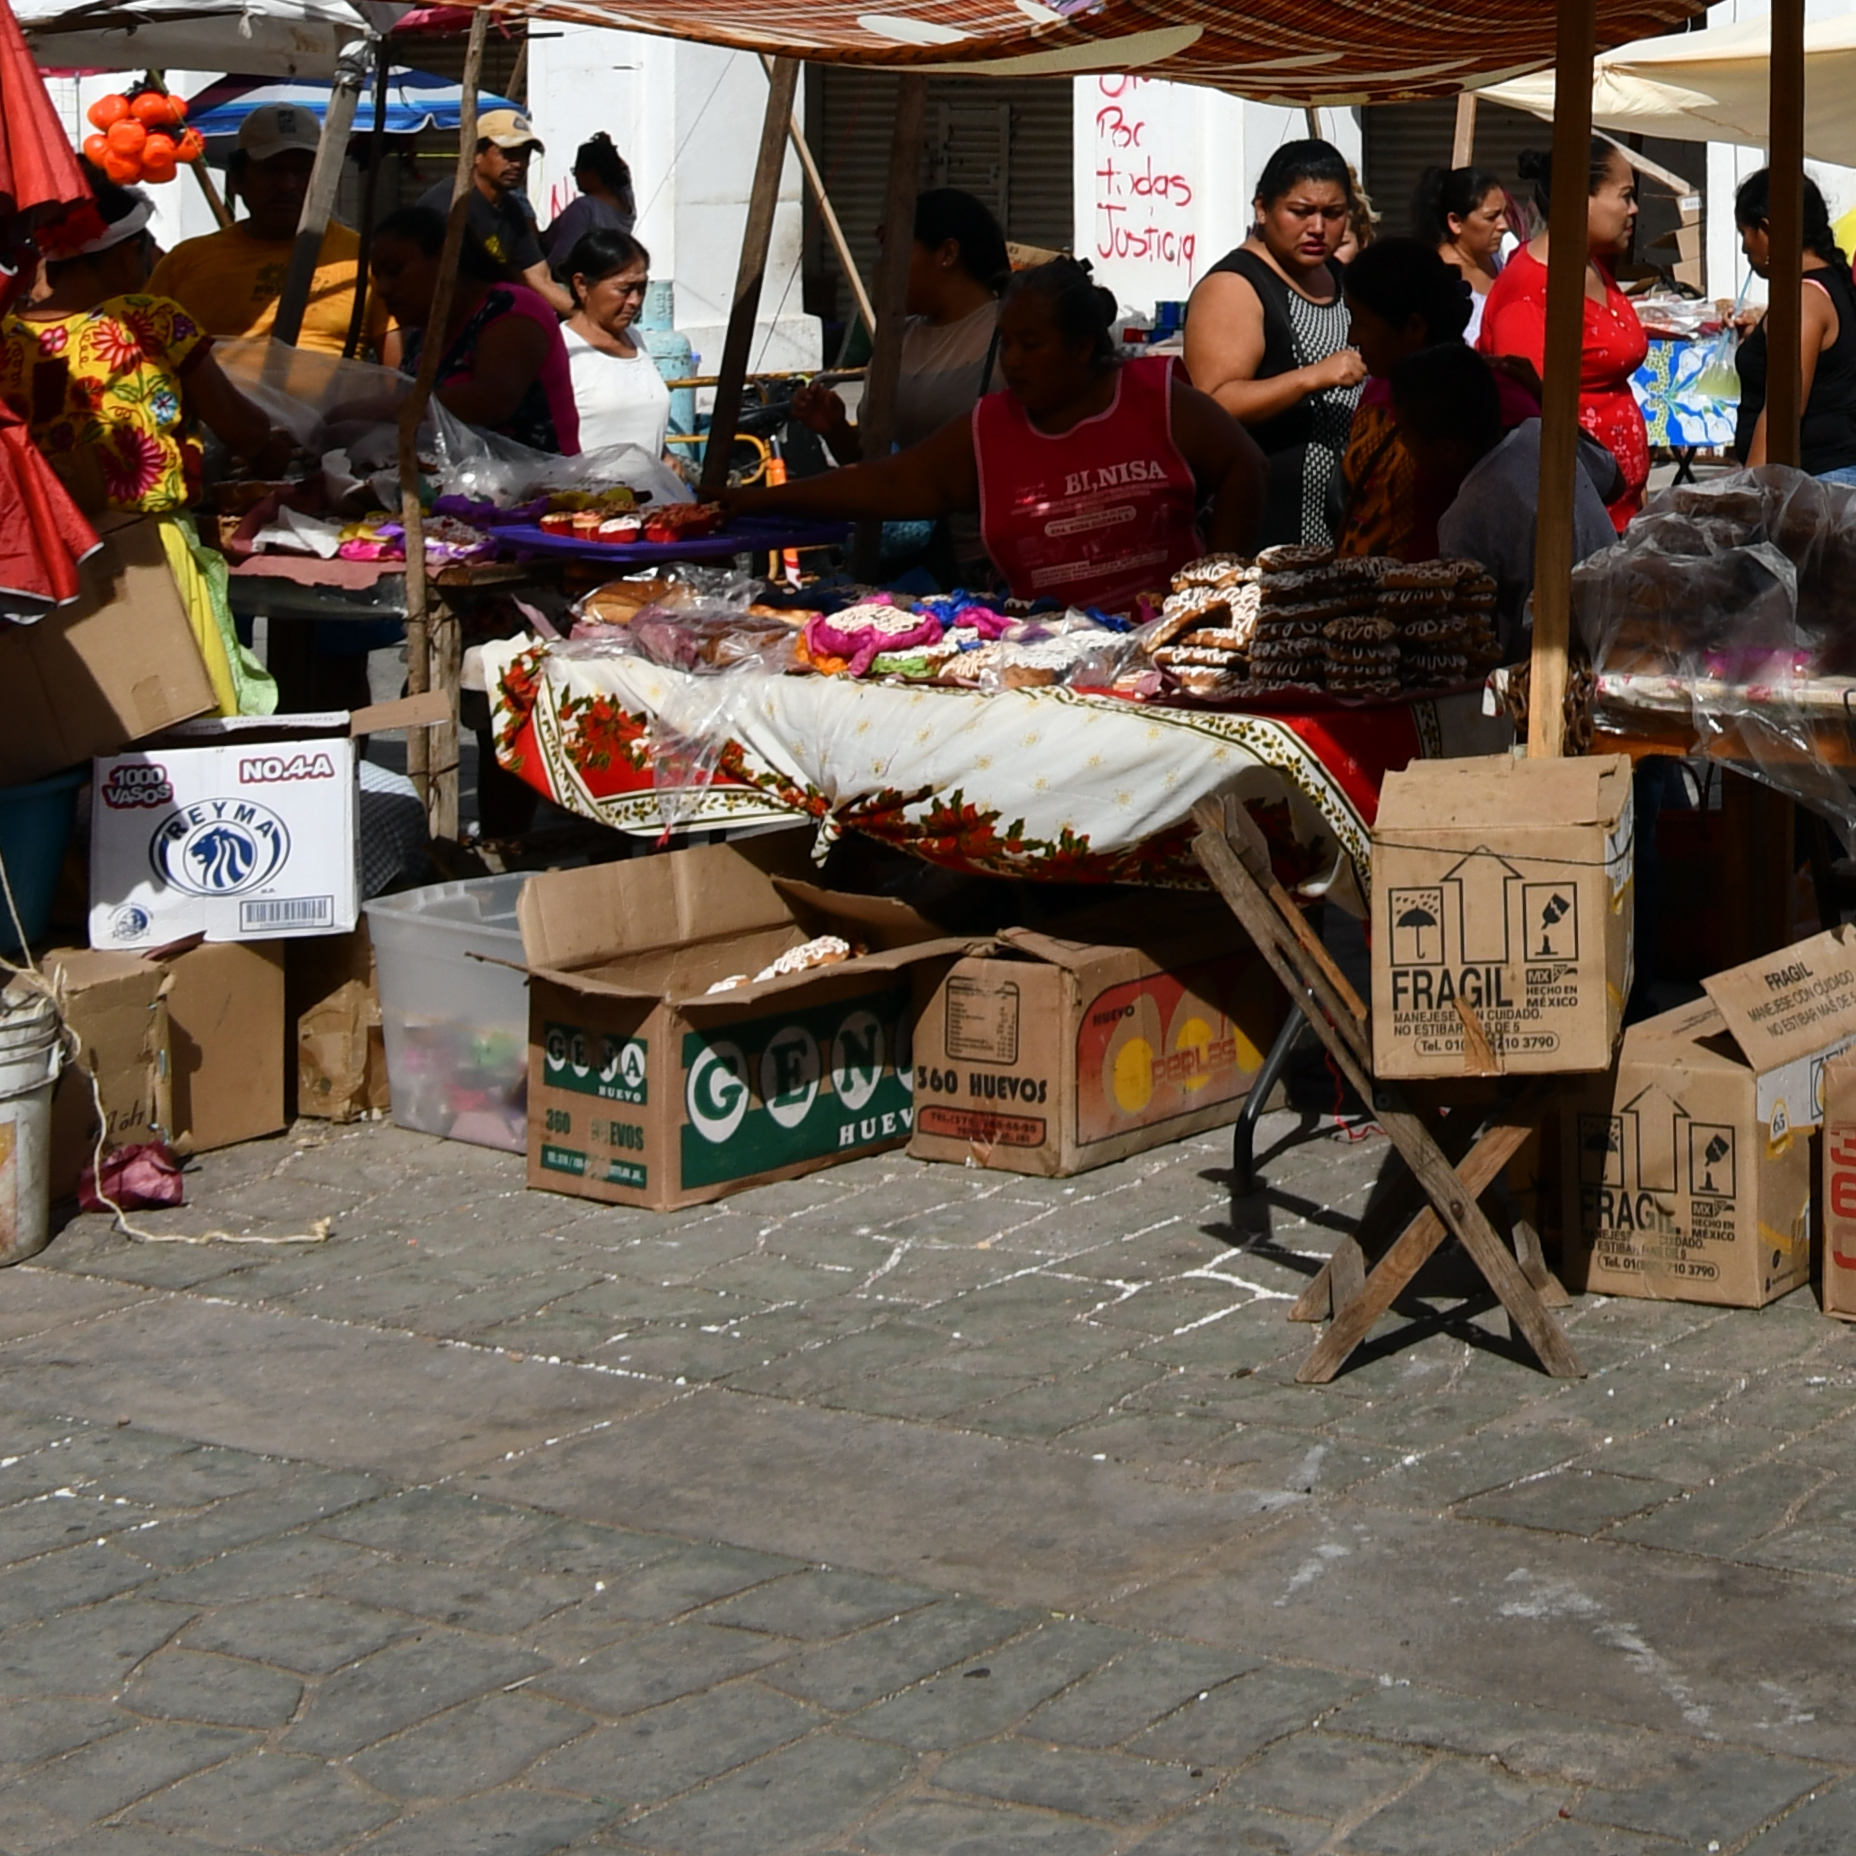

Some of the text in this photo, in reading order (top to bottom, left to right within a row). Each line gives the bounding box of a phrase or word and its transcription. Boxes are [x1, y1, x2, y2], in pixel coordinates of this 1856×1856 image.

[114, 767, 165, 787] 1000
[105, 784, 171, 805] VASOS
[167, 801, 277, 842] REYMA
[1528, 971, 1550, 983] MX
[1764, 961, 1813, 992] FRAGIL
[1392, 967, 1514, 1011] FRAGIL
[1526, 985, 1578, 996] HECHO EN
[1793, 987, 1815, 1004] CON
[1813, 970, 1854, 995] CUIDADO
[1526, 996, 1578, 1008] MÉXICO
[1394, 1011, 1455, 1024] MANEJESE
[1766, 1022, 1783, 1037] NO
[1836, 994, 1851, 1009] DE
[1394, 1025, 1411, 1036] NO
[1495, 1022, 1510, 1033] DE
[1513, 1022, 1520, 1033] 5
[1421, 1040, 1442, 1051] Tel.
[1522, 1037, 1554, 1048] 3790
[694, 1023, 912, 1121] GEN
[599, 1086, 642, 1103] HUEVO
[918, 1066, 1047, 1104] 360 HUEVOS
[839, 1107, 914, 1147] HUEV
[1772, 1110, 1785, 1132] 65
[591, 1118, 644, 1151] EVOS
[1694, 1204, 1711, 1215] MX
[1692, 1218, 1735, 1230] HECHO EN
[1689, 1264, 1715, 1277] 3790
